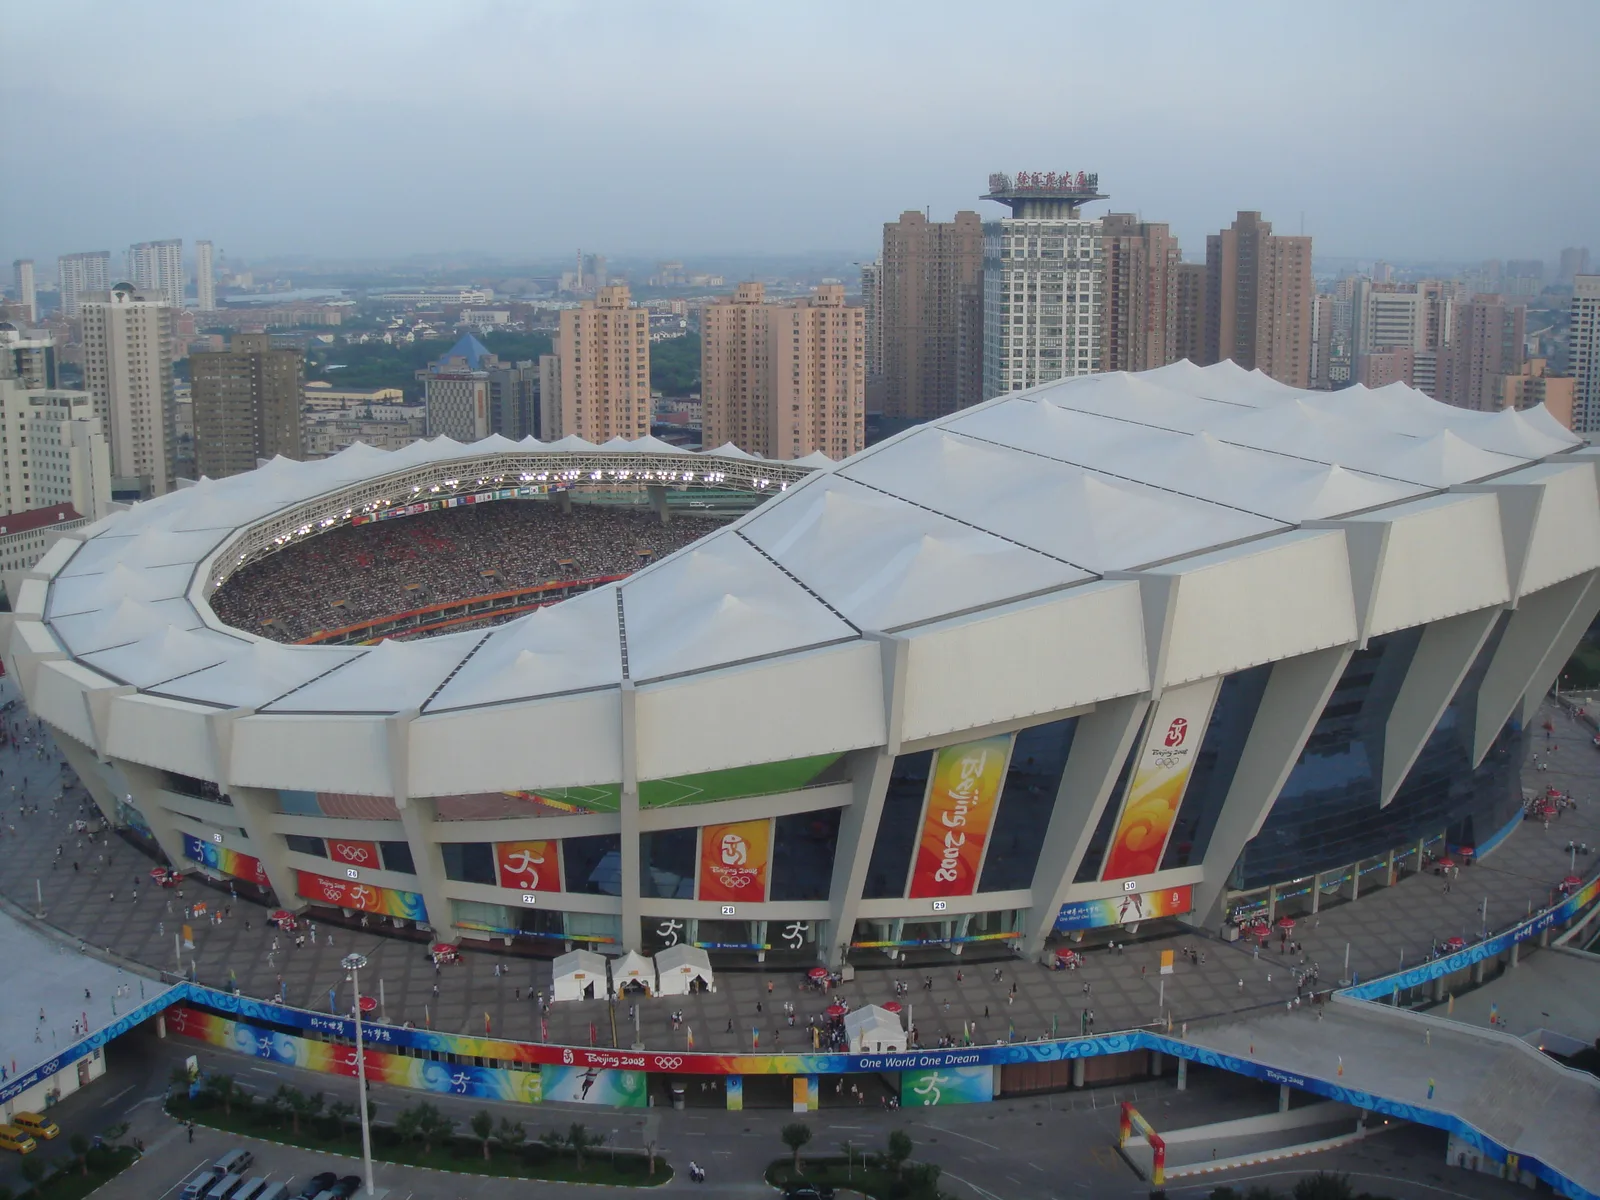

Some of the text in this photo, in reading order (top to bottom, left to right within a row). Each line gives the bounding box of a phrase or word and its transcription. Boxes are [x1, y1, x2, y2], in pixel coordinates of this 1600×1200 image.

[935, 750, 987, 882] Beijing 2008
[710, 866, 737, 875] Beijing
[585, 1052, 645, 1066] Beijing 2008
[860, 1054, 979, 1068] One World One Dream
